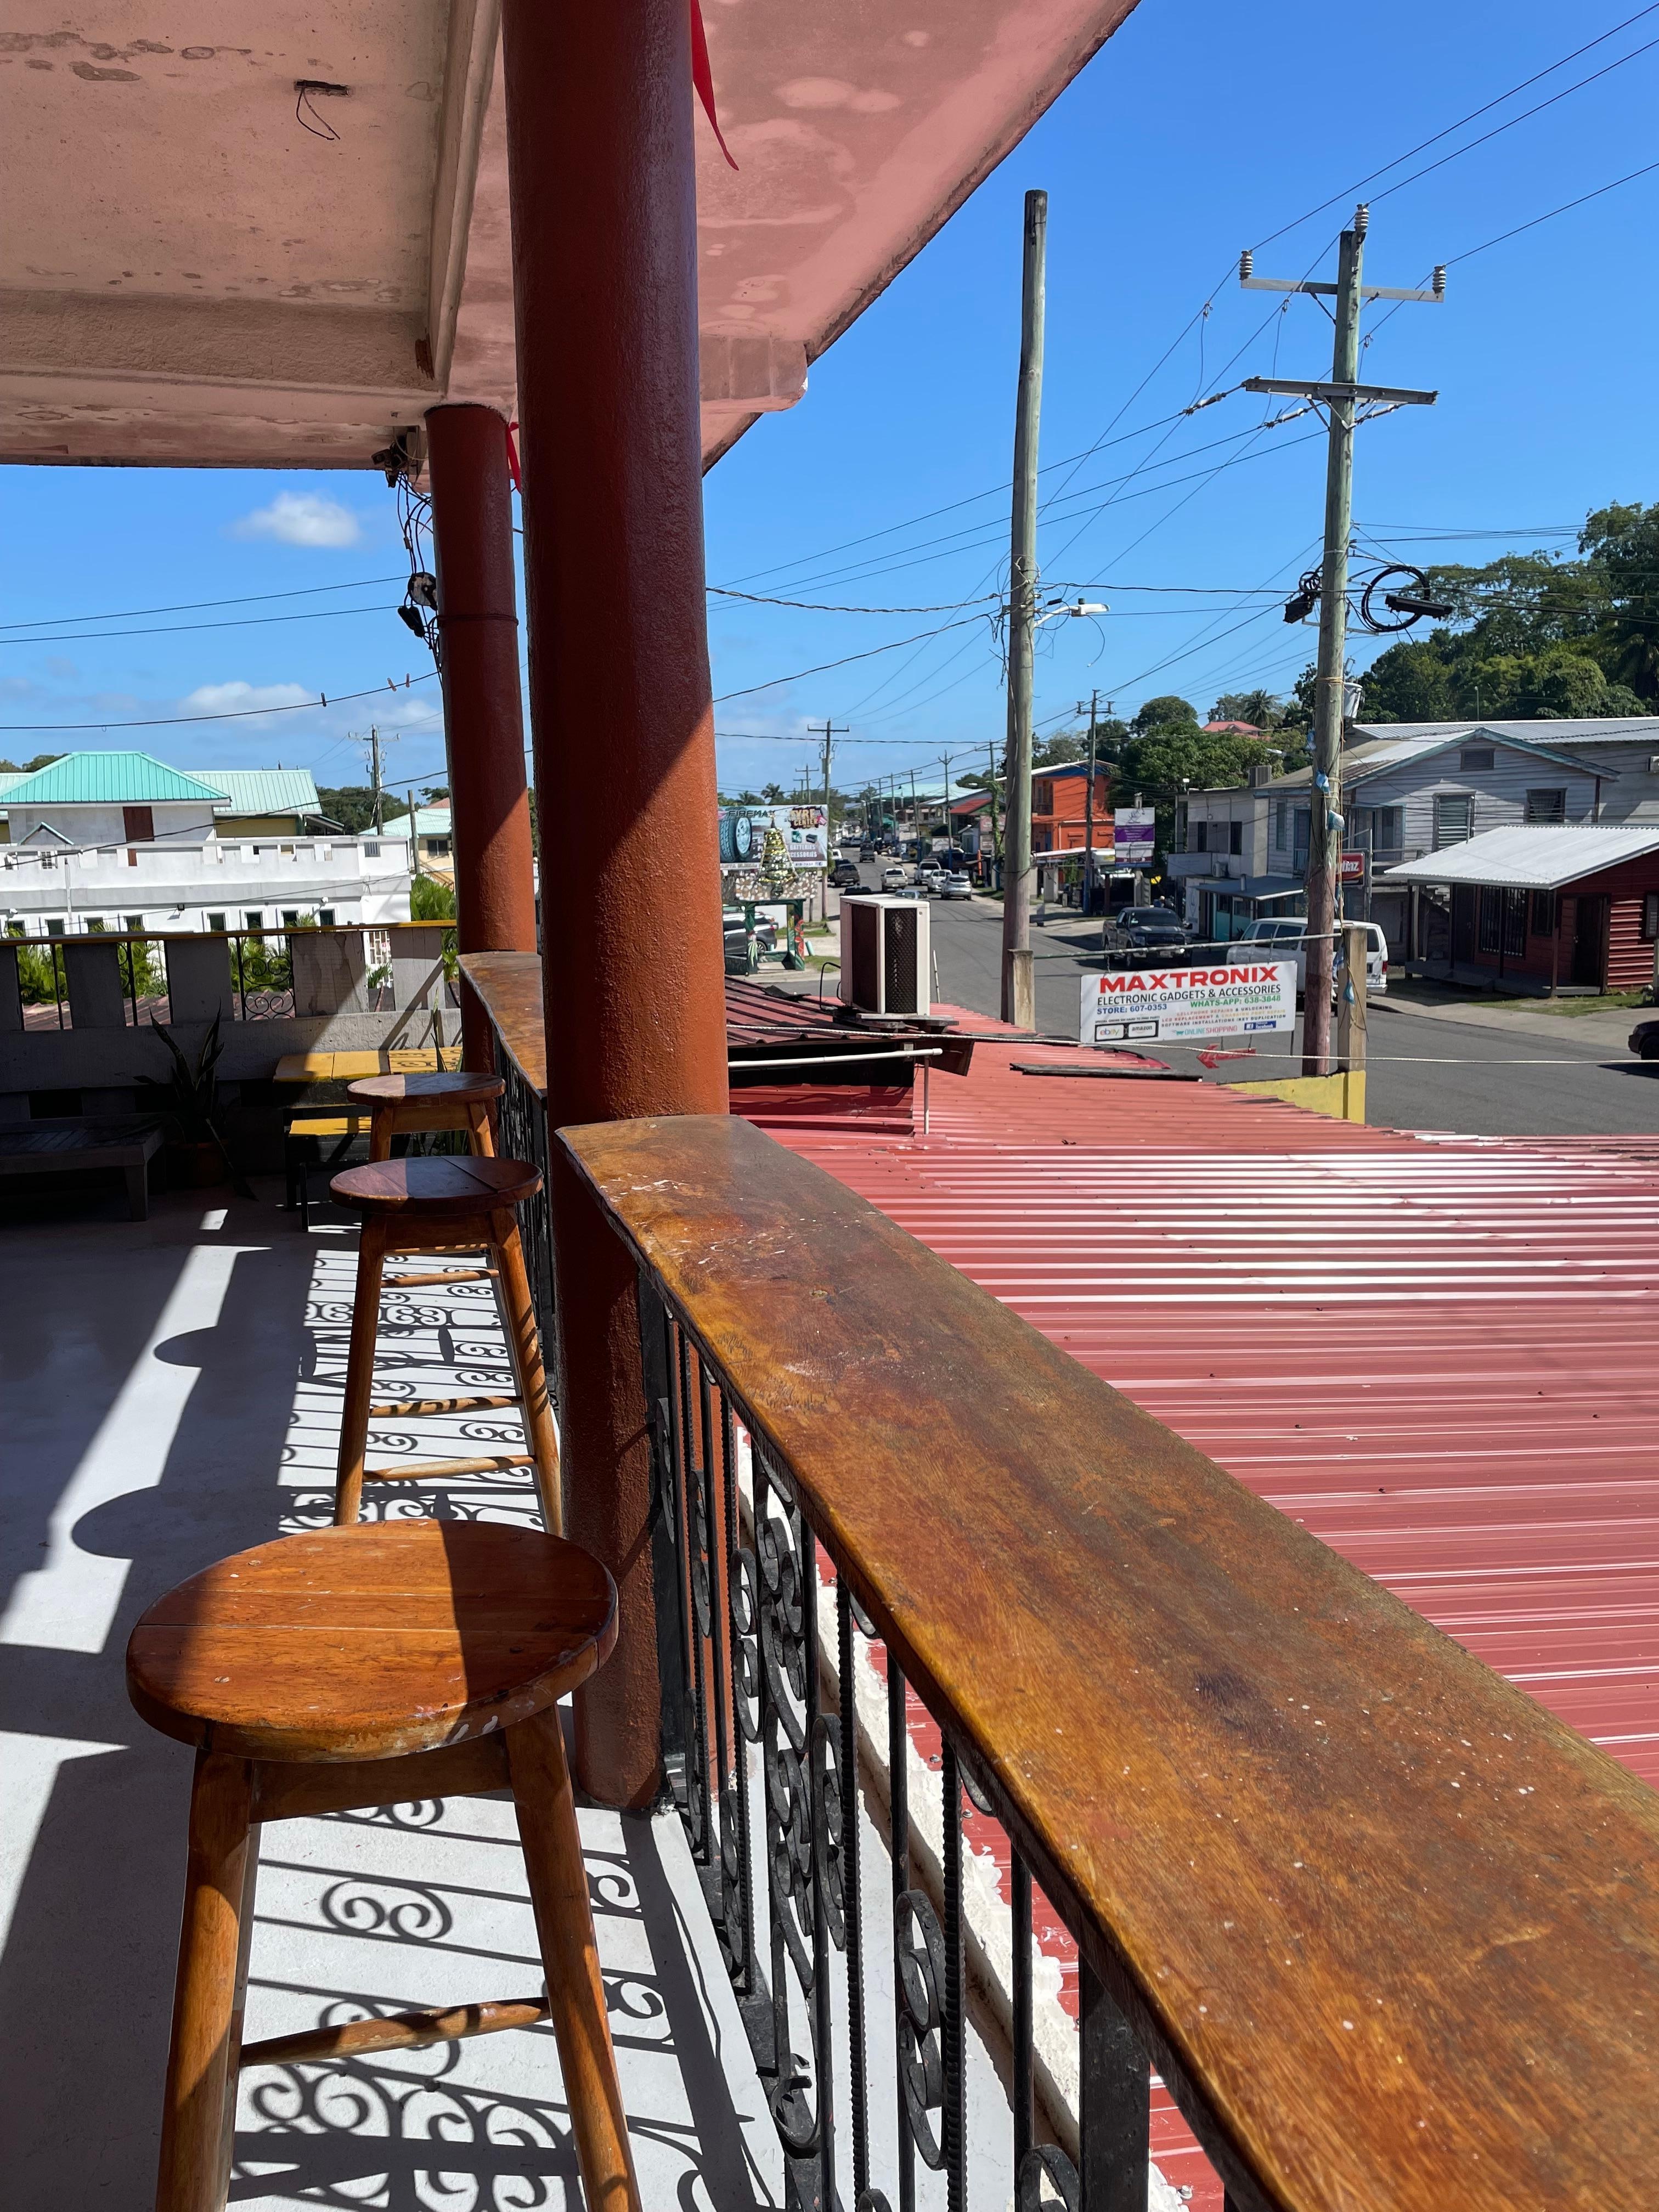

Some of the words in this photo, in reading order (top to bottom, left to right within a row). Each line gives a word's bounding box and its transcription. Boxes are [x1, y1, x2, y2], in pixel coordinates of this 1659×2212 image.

[1100, 966, 1279, 994] MAXTRONIX
[1097, 993, 1157, 1006] ELECTRONIC
[1160, 989, 1205, 1001] GADGETS
[1209, 989, 1216, 997] &
[1219, 984, 1281, 997] ACCESSORIES
[1190, 998, 1242, 1008] WHATS-APP:
[1244, 995, 1281, 1005] 638-3848
[1097, 1007, 1127, 1015] STORE:
[1130, 1003, 1167, 1012] 607-0353
[1100, 1028, 1120, 1036] ebay
